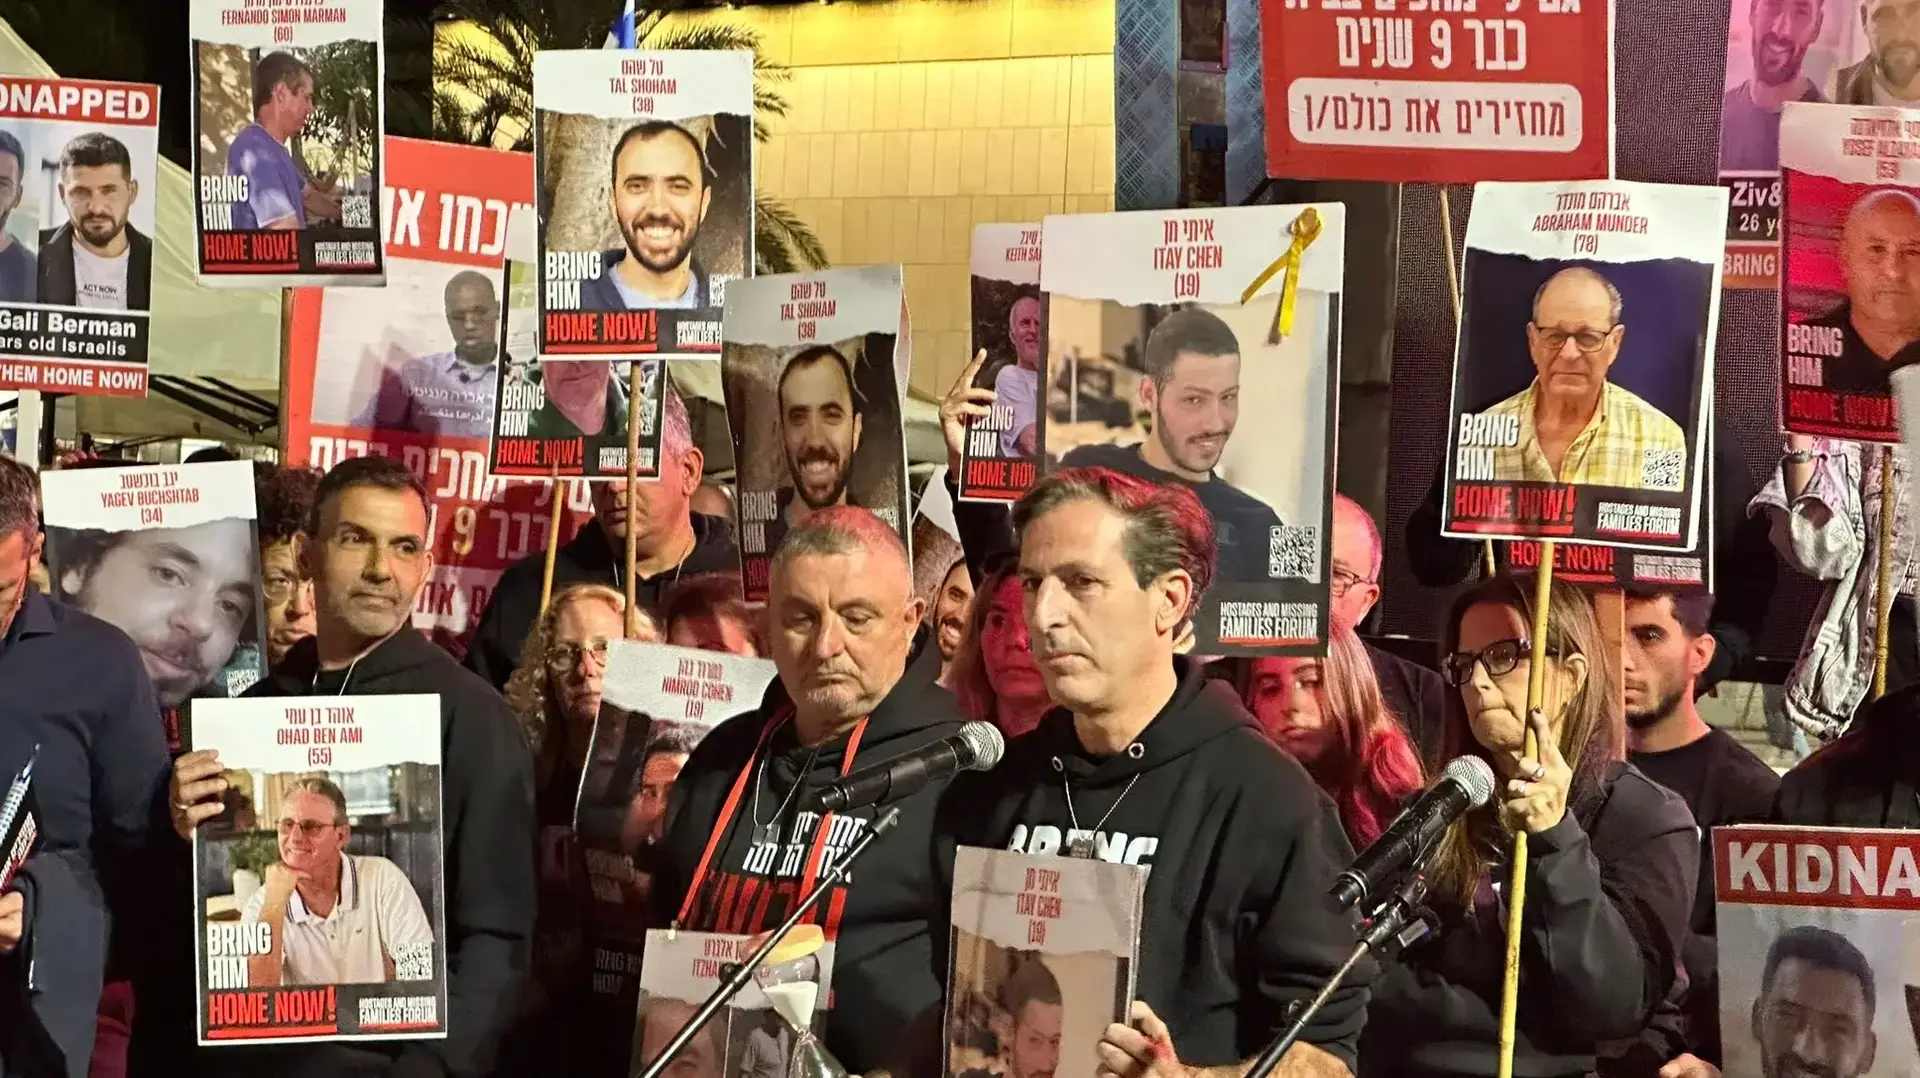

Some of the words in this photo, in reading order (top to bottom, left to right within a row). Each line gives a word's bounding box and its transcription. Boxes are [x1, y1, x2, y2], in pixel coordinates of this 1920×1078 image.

[221, 9, 269, 25] FERNANDO
[271, 9, 300, 24] SIMON
[303, 8, 346, 23] MARMAN
[1336, 17, 1413, 68] שנים
[1430, 19, 1452, 69] 9
[1463, 19, 1527, 70] כבר
[621, 60, 646, 75] שהם
[649, 58, 664, 75] טל
[609, 78, 628, 94] TAL
[631, 79, 677, 94] SHOHAM
[632, 96, 654, 114] (38)
[1405, 98, 1441, 134] את
[1456, 101, 1565, 137] מחזירים
[202, 175, 248, 203] BRING
[1588, 192, 1630, 211] אברהם
[203, 204, 232, 230] HIM
[438, 193, 532, 255] כחו
[1532, 213, 1593, 232] ABRAHAM
[1596, 214, 1648, 234] MUNDER
[1740, 213, 1759, 232] 26
[1164, 220, 1178, 245] חן
[1183, 219, 1214, 242] איתי
[204, 234, 248, 260] HOME
[252, 231, 298, 260] NOW!
[1006, 247, 1027, 261] KEITH
[1154, 246, 1182, 269] ITAY
[1187, 245, 1222, 268] CHEN
[1573, 234, 1600, 255] (78)
[545, 251, 601, 280] BRING
[546, 281, 581, 310] HIM
[814, 281, 826, 298] טל
[1174, 271, 1200, 299] (19)
[780, 302, 794, 320] TAL
[798, 300, 836, 318] SHOHAM
[0, 310, 39, 332] Gali
[48, 313, 136, 338] Berman
[545, 313, 597, 342] HOME
[603, 310, 657, 341] NOW!
[798, 321, 816, 341] (38)
[29, 336, 55, 352] old
[62, 337, 126, 356] Israelis
[1787, 323, 1843, 357] BRING
[0, 364, 38, 383] HEM
[43, 366, 94, 387] HOME
[99, 370, 143, 390] NOW!
[1787, 355, 1823, 386] HIM
[503, 386, 545, 410] BRING
[500, 412, 528, 436] HIM
[1458, 413, 1520, 447] BRING
[497, 440, 540, 465] HOME
[544, 437, 583, 465] NOW!
[969, 426, 998, 457] HIM
[967, 461, 1007, 486] HOME
[1456, 447, 1496, 480] HIM
[162, 472, 178, 487] יגב
[101, 492, 134, 508] YAGEV
[137, 488, 199, 505] BUCHSHTAB
[742, 488, 777, 520] BRING
[1454, 485, 1512, 517] HOME
[1517, 482, 1576, 522] NOW!
[141, 507, 163, 525] (34)
[1597, 513, 1642, 533] FAMILIES
[1643, 517, 1680, 535] FORUM
[452, 506, 477, 556] 9
[743, 522, 766, 553] HIM
[1566, 545, 1614, 573] NOW!
[1220, 602, 1262, 617] HOSTAGES
[1263, 602, 1280, 617] AND
[1281, 603, 1318, 618] MISSING
[1220, 617, 1273, 639] FAMILIES
[1275, 618, 1318, 640] FORUM
[662, 677, 700, 697] NIMROD
[285, 708, 306, 724] עמי
[310, 708, 321, 726] בן
[326, 707, 354, 724] אוהד
[685, 699, 704, 719] (19)
[277, 728, 310, 745] OHAD
[313, 728, 336, 744] BEN
[340, 727, 363, 743] AMI
[308, 747, 332, 767] (55)
[1728, 841, 1920, 897] KIDNA
[1016, 893, 1036, 916] ITAY
[1037, 896, 1061, 919] CHEN
[207, 922, 272, 955] BRING
[1028, 918, 1046, 945] (19)
[208, 957, 248, 989] HIM
[209, 993, 268, 1025] HOME
[275, 986, 337, 1024] NOW!
[360, 1007, 401, 1024] FAMILIES
[403, 1006, 437, 1023] FORUM
